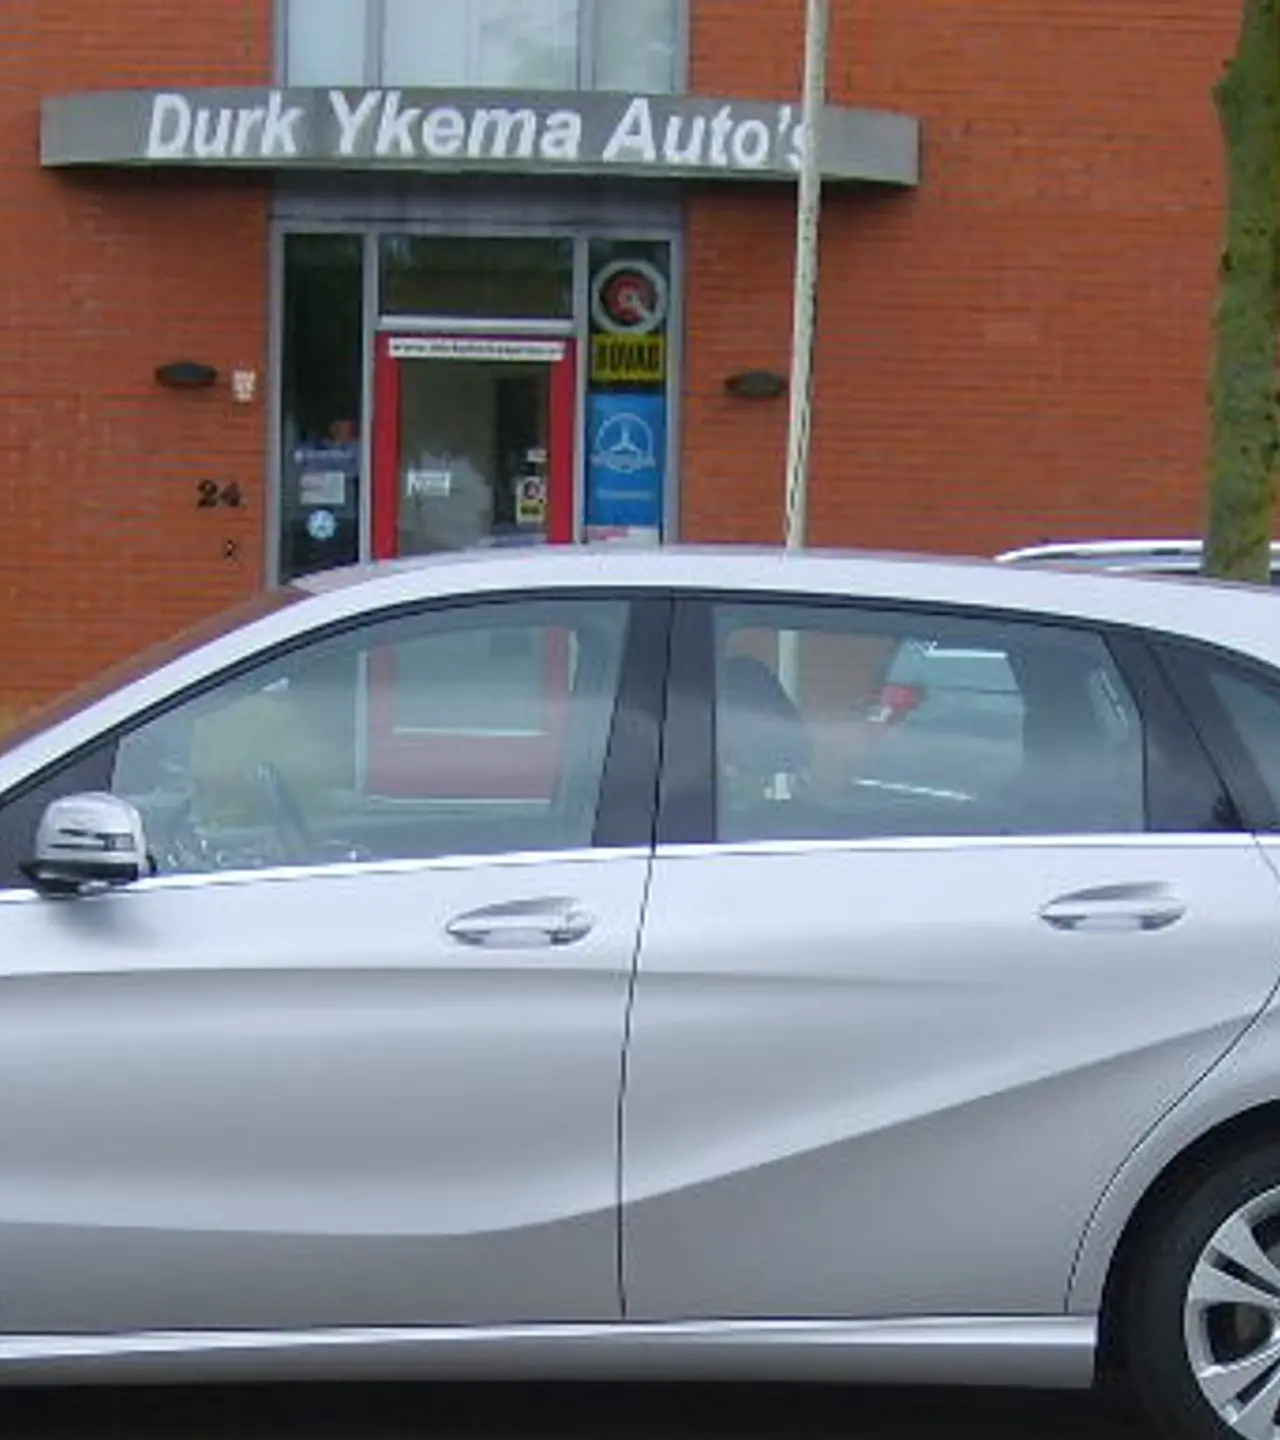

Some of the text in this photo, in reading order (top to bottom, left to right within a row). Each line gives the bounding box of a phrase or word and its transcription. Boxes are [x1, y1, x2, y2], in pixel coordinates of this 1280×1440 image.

[147, 88, 306, 159] Durk
[328, 88, 582, 161] Ykema
[197, 478, 243, 508] 24
